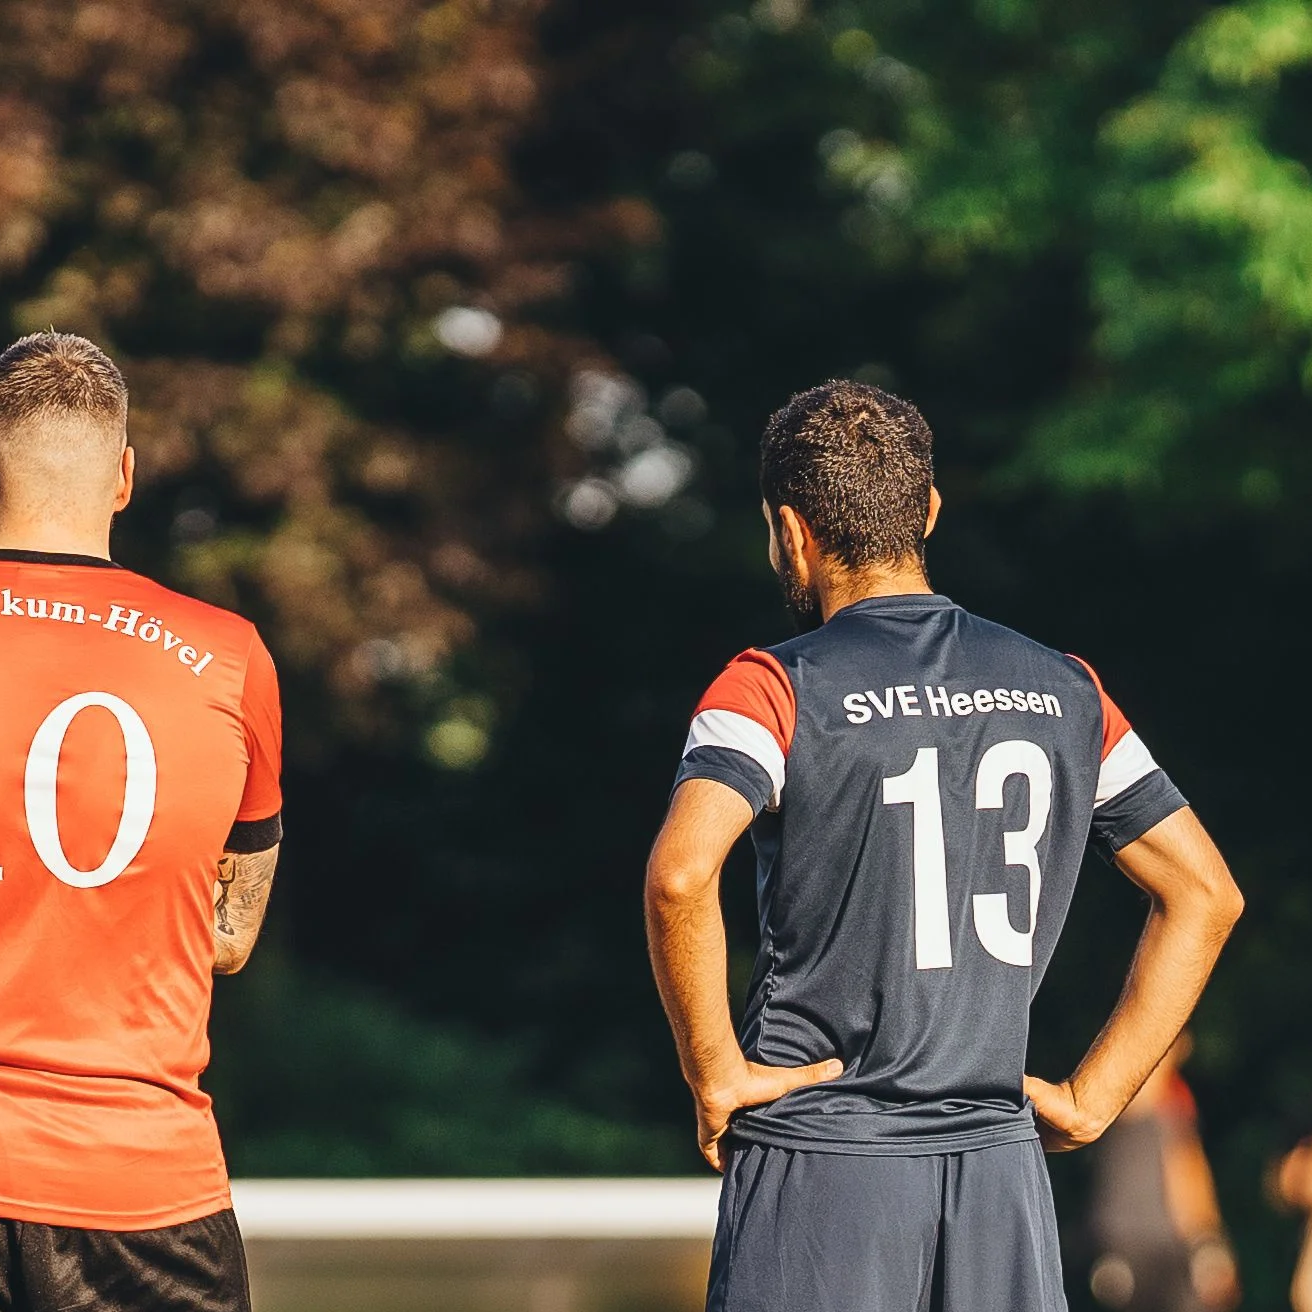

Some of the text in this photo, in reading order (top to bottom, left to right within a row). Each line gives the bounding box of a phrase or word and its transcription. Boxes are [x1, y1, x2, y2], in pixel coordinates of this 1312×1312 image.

[842, 685, 1063, 724] SVE Heessen
[882, 739, 1053, 970] 13
